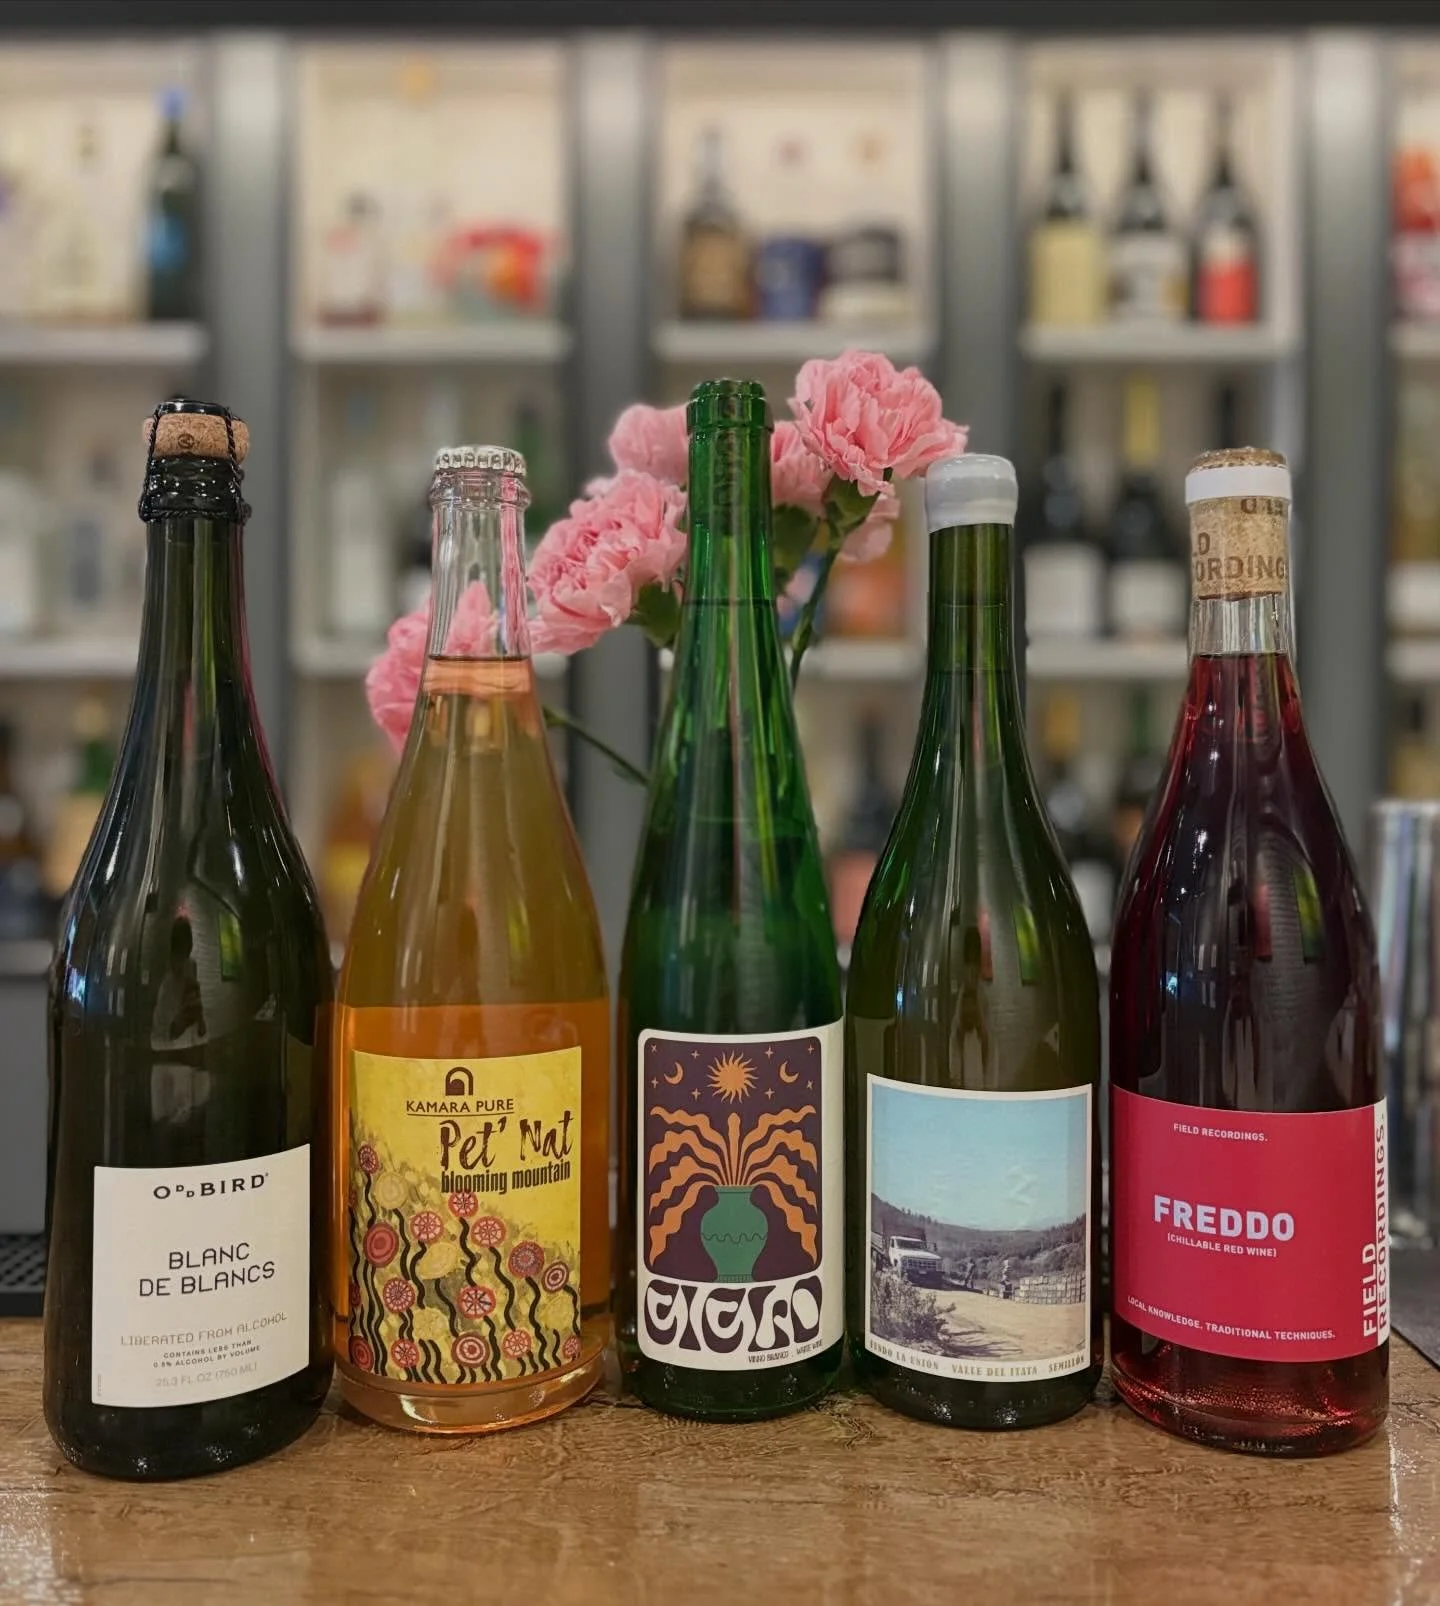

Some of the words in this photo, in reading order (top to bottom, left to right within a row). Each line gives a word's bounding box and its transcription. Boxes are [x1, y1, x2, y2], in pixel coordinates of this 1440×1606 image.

[406, 1100, 470, 1113] KAMARA
[476, 1098, 514, 1112] PURE
[519, 1110, 574, 1161] Nat
[1173, 1123, 1199, 1135] FIELD
[1201, 1127, 1268, 1142] RECORDINGS.
[441, 1169, 507, 1195] blooming
[511, 1159, 571, 1189] mountain
[1154, 1194, 1295, 1241] FREDDO
[1376, 1113, 1387, 1329] RECORDINGS.
[169, 1242, 250, 1270] BLANC
[1223, 1244, 1244, 1255] RED
[139, 1278, 171, 1297] DE
[181, 1261, 276, 1294] BLANCS
[1362, 1242, 1377, 1337] FIELD
[120, 1332, 194, 1347] LIBERATED
[199, 1328, 233, 1343] FROM
[237, 1311, 288, 1334] ALCOHOL
[1127, 1295, 1147, 1312] LOCAL
[1148, 1304, 1203, 1329] KNOWLEDGE.
[1205, 1322, 1272, 1340] TRADITIONAL
[1274, 1330, 1336, 1341] TECHNIQUES.
[163, 1349, 206, 1359] CONTAINS
[208, 1345, 229, 1354] LESS
[231, 1340, 252, 1350] THAN
[175, 1357, 214, 1367] ALCOHOL
[217, 1353, 227, 1361] BY
[230, 1345, 261, 1359] VOLUME
